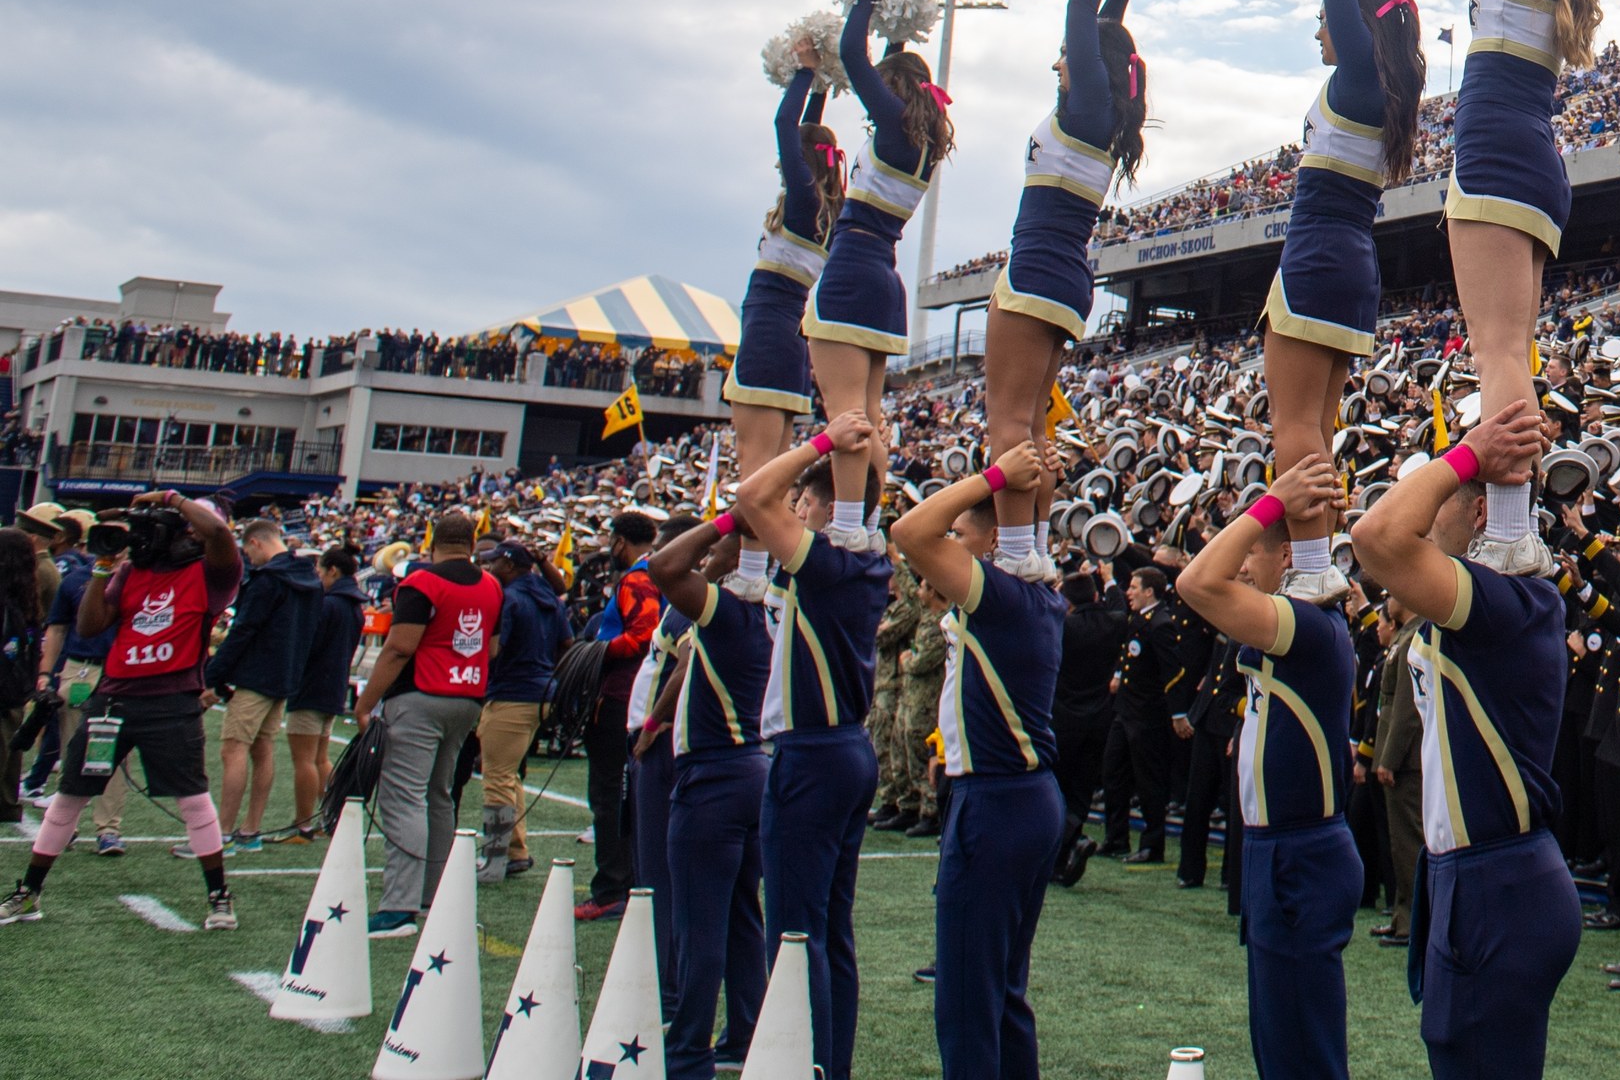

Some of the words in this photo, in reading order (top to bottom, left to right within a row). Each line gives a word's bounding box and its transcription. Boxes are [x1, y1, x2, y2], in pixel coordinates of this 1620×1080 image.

[1138, 235, 1216, 263] INCHON-SEOUL
[616, 396, 636, 420] 16
[125, 642, 174, 665] 110
